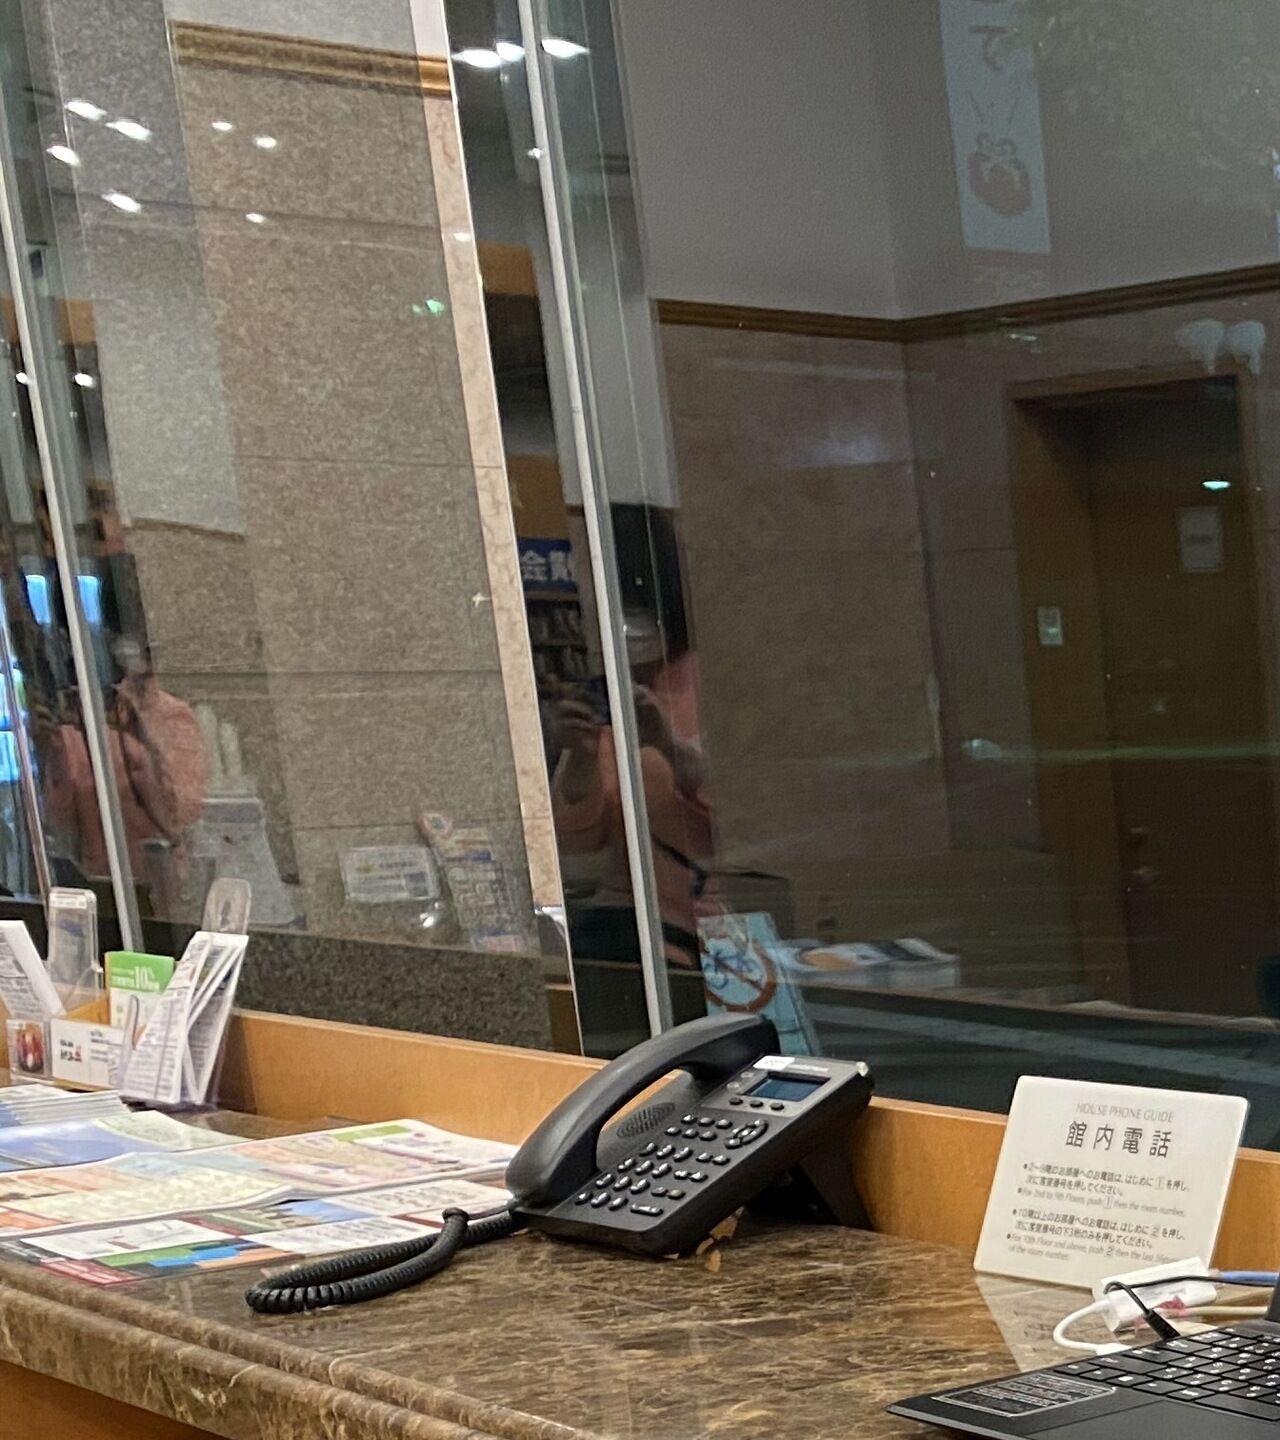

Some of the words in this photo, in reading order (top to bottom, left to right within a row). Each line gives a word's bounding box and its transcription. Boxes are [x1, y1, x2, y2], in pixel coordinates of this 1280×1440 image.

[1075, 1102, 1109, 1117] HOUSE
[1109, 1105, 1143, 1120] PHONE
[1143, 1108, 1175, 1123] GUIDE
[1065, 1120, 1174, 1158] 館内電話
